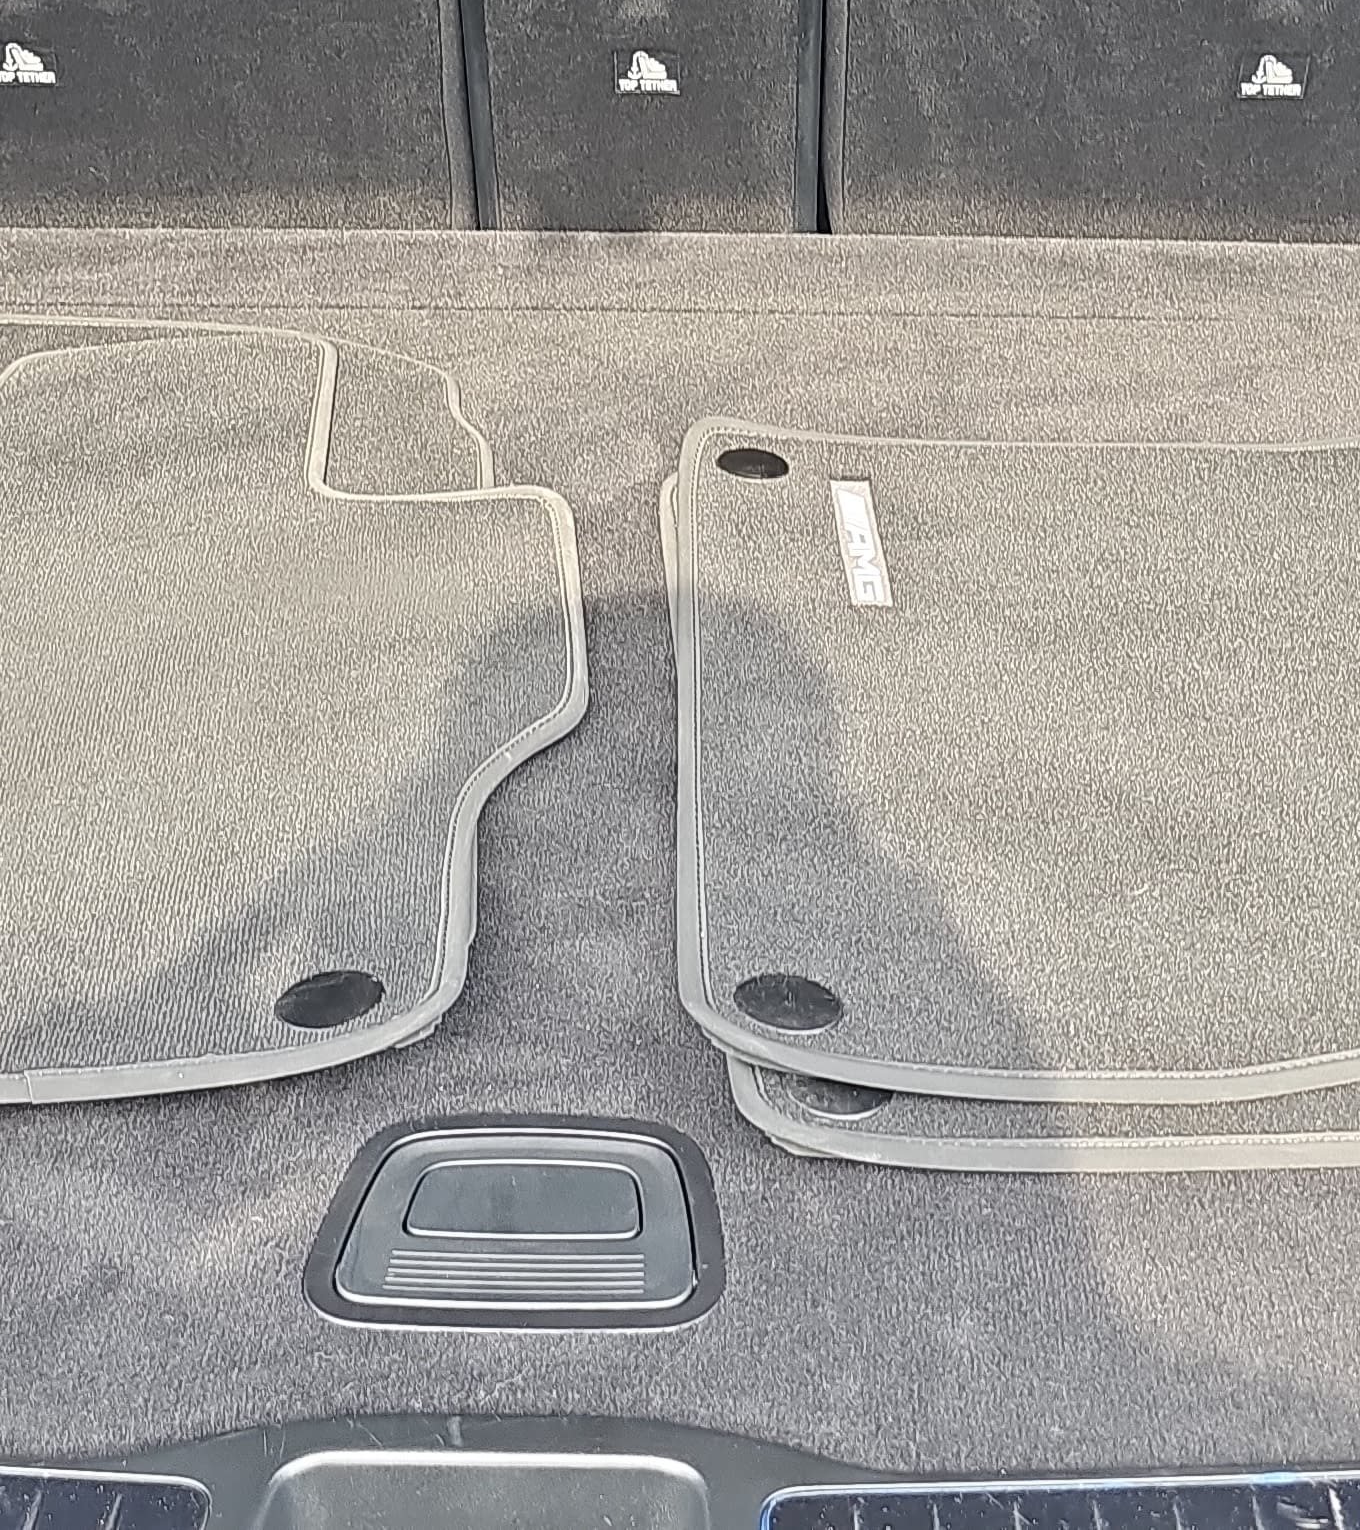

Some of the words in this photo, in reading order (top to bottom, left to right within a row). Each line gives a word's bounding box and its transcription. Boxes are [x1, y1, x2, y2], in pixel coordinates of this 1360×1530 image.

[16, 71, 56, 84] TETHER
[618, 78, 638, 91] TOP
[639, 78, 677, 92] TETHER
[1241, 82, 1261, 96] TOP
[1262, 83, 1301, 97] TETHER
[843, 523, 886, 602] AMG
